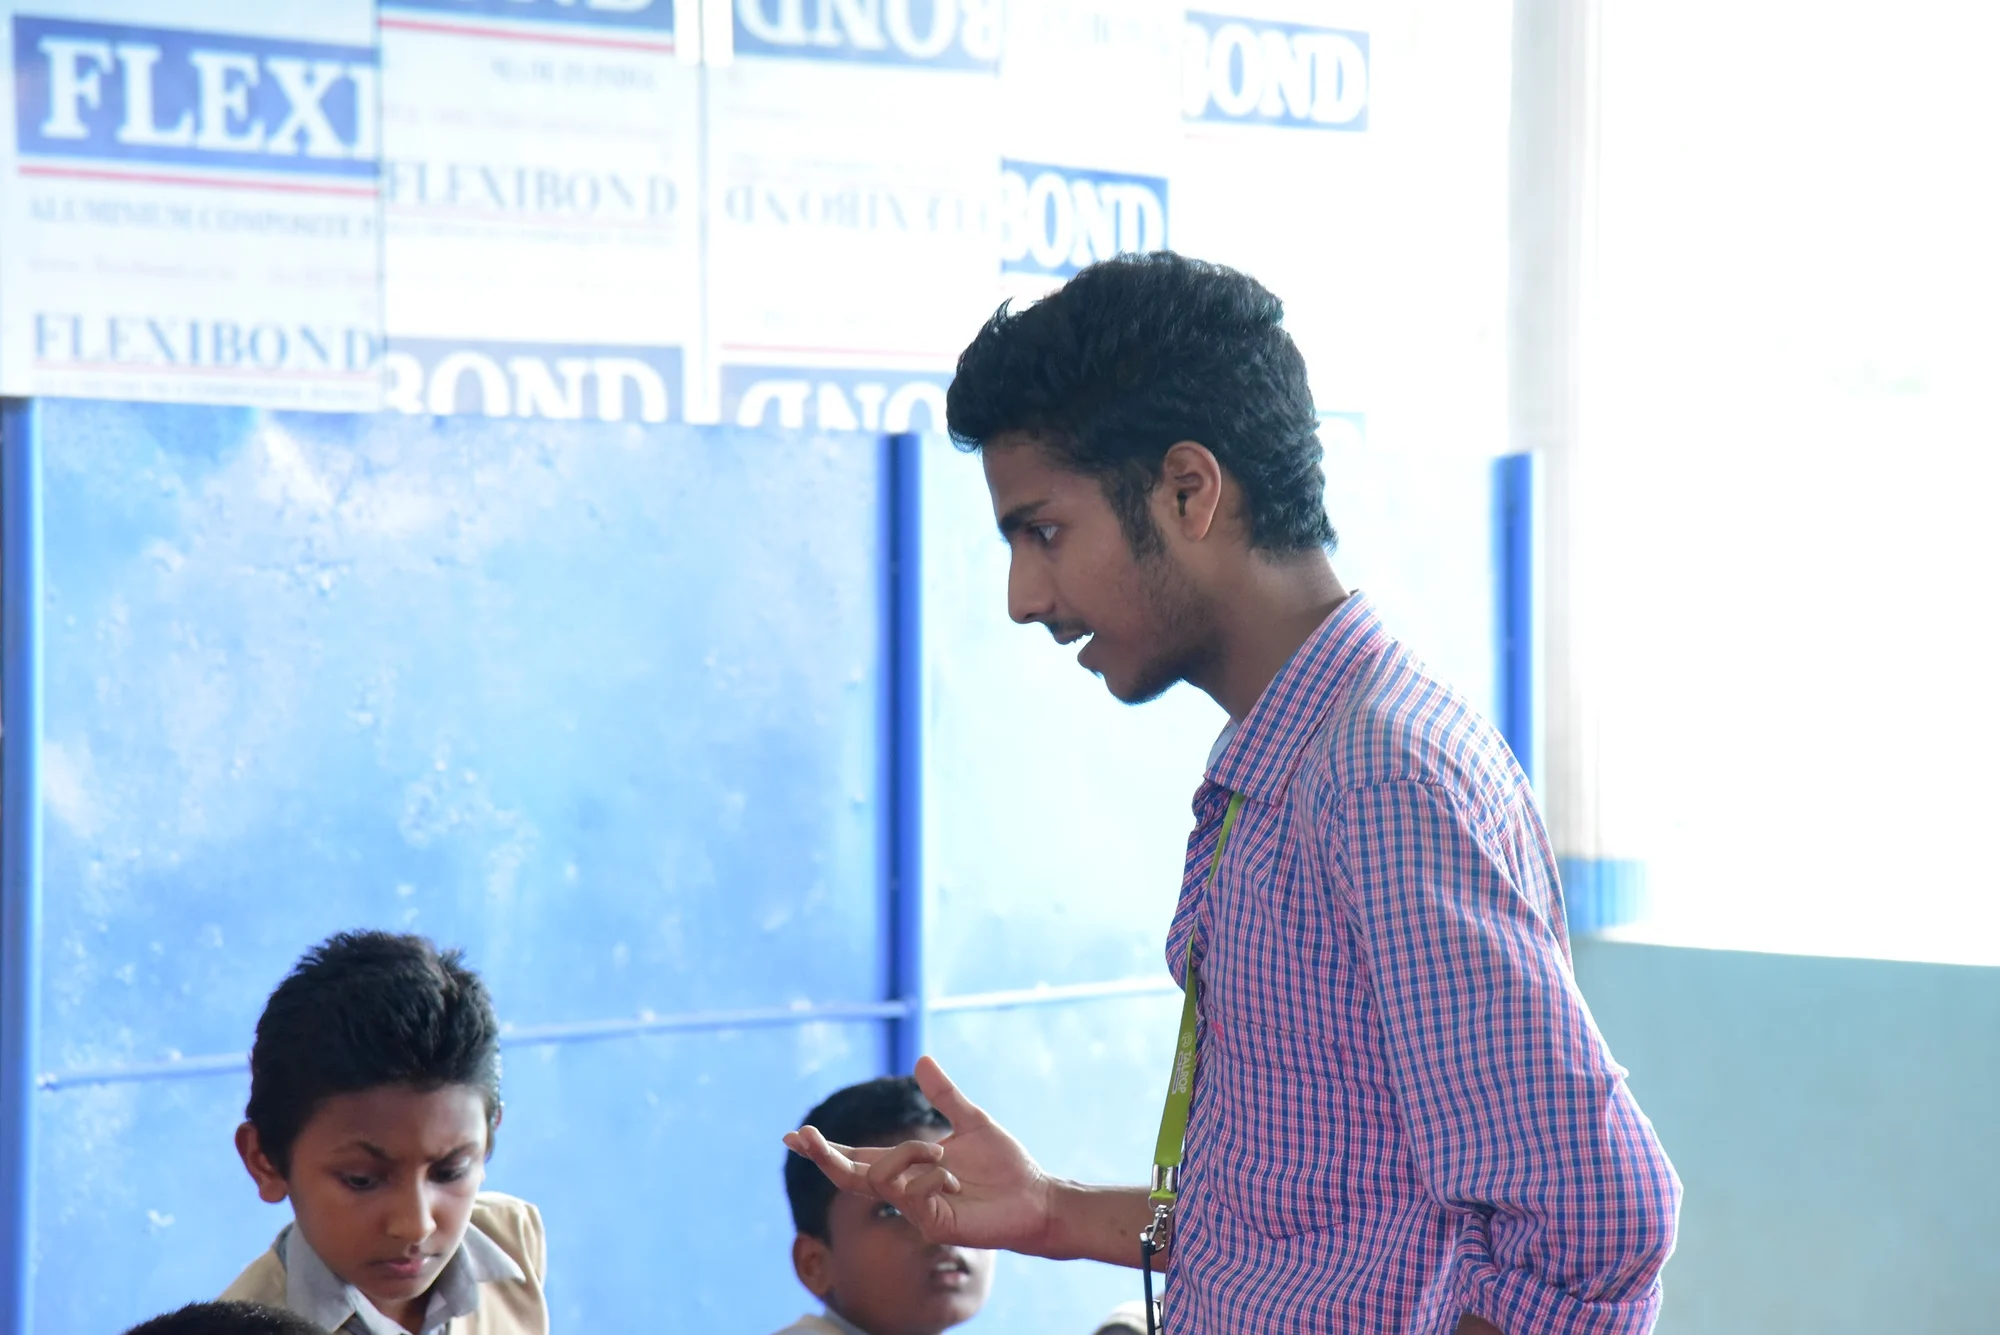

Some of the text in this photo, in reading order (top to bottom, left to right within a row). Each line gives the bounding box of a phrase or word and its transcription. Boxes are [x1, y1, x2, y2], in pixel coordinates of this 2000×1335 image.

[39, 37, 377, 155] FLEXI
[384, 158, 679, 216] FLEXIBOND
[33, 311, 379, 373] FLEXIBOND
